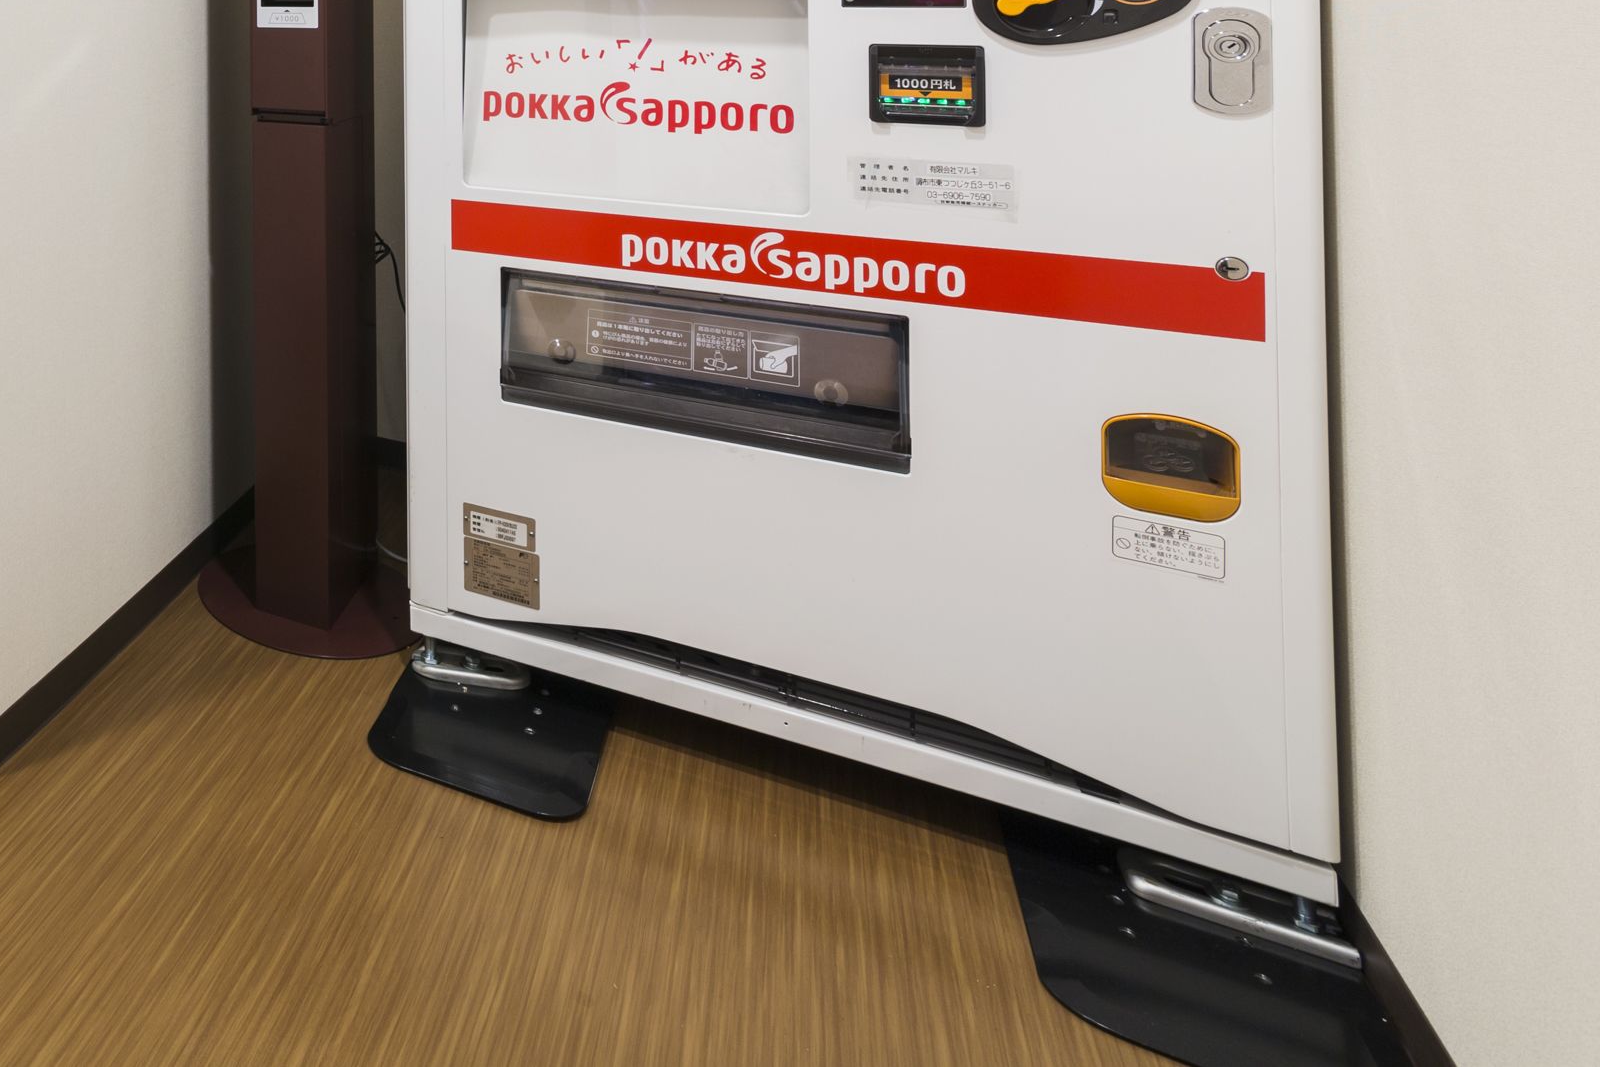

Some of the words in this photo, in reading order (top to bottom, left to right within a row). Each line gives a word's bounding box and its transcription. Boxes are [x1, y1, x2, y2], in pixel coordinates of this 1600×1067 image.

[894, 78, 957, 91] 1000円札
[926, 190, 992, 203] 03-6906-7590
[1162, 525, 1191, 541] 警告
